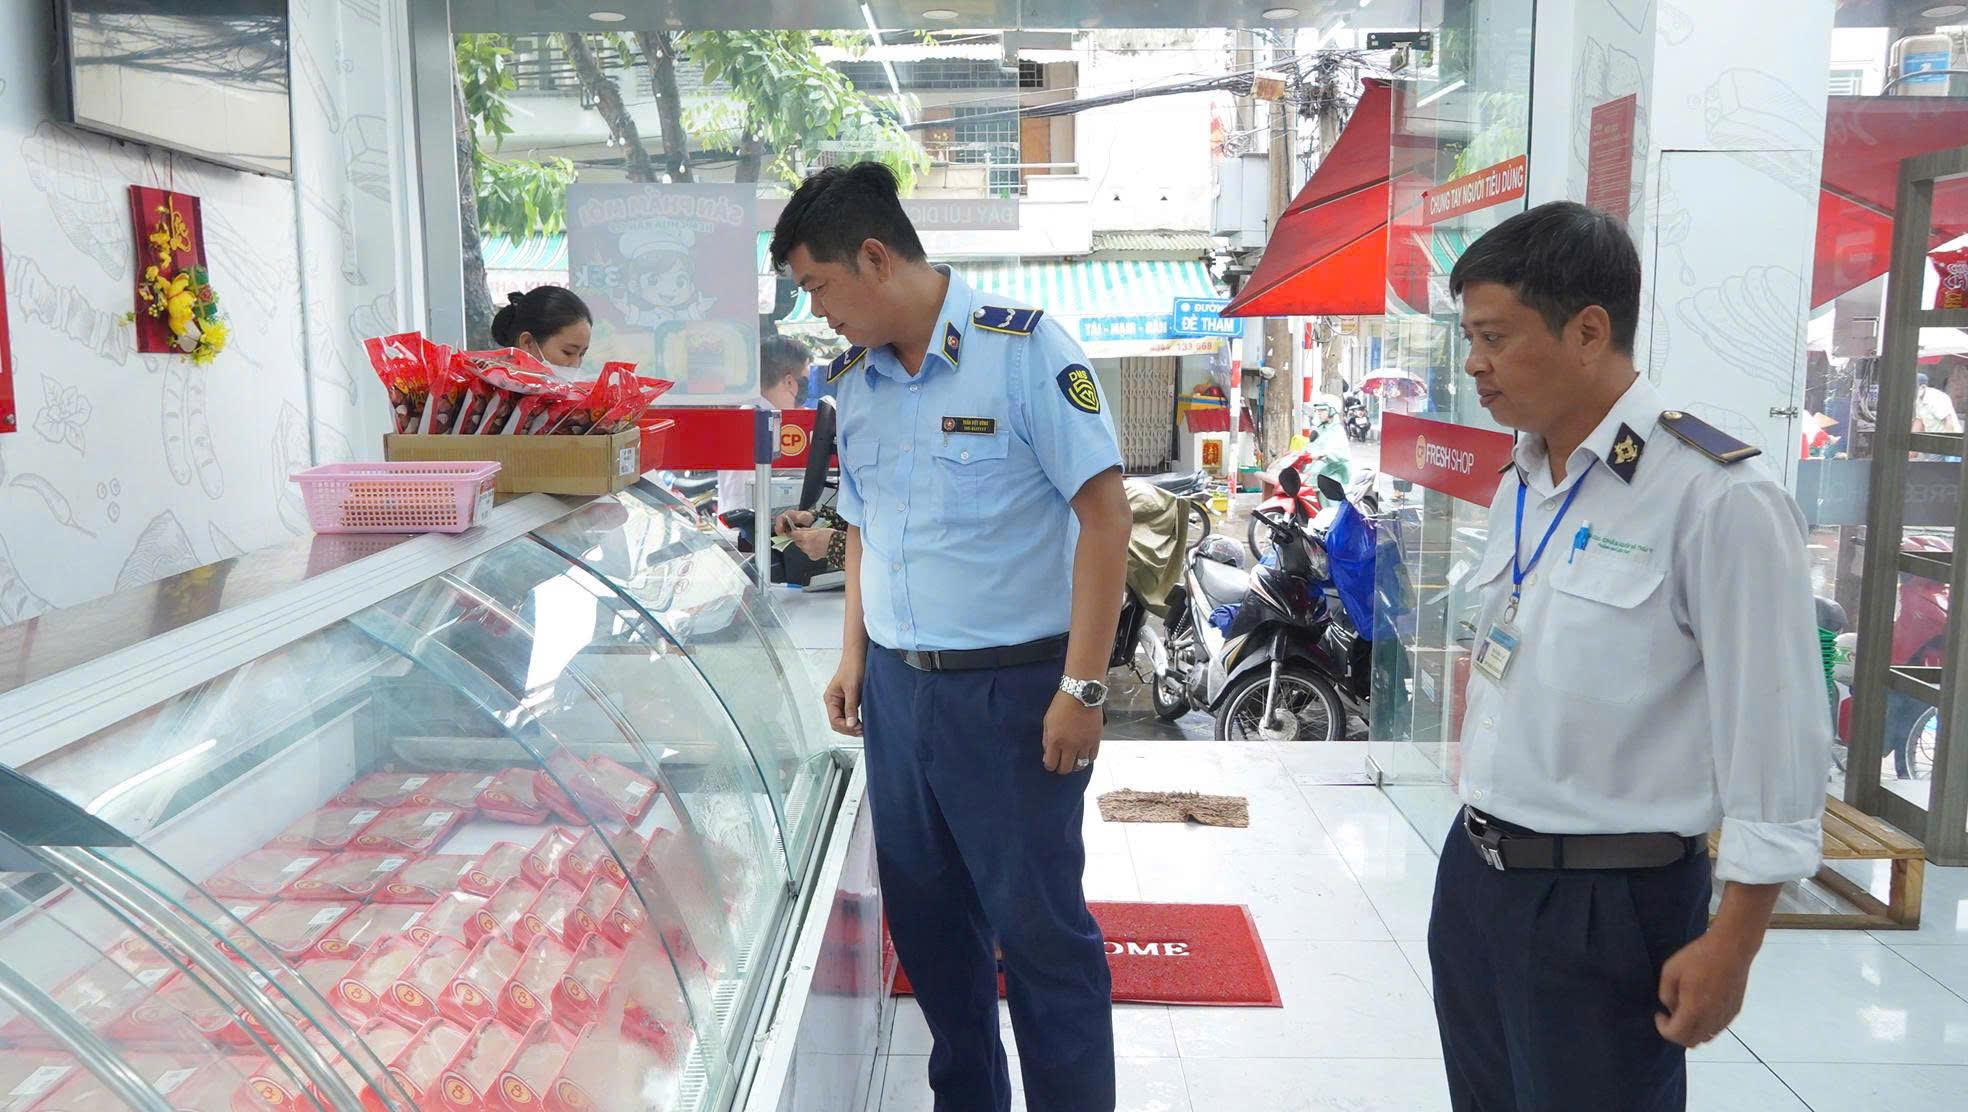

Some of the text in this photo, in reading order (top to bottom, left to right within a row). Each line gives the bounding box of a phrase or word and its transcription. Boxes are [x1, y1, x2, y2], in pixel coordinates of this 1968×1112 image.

[1430, 191, 1450, 215] CHUNG
[1451, 187, 1462, 208] TAY
[1502, 164, 1524, 192] DÙNG
[781, 433, 802, 447] CP
[1103, 941, 1190, 957] OME
